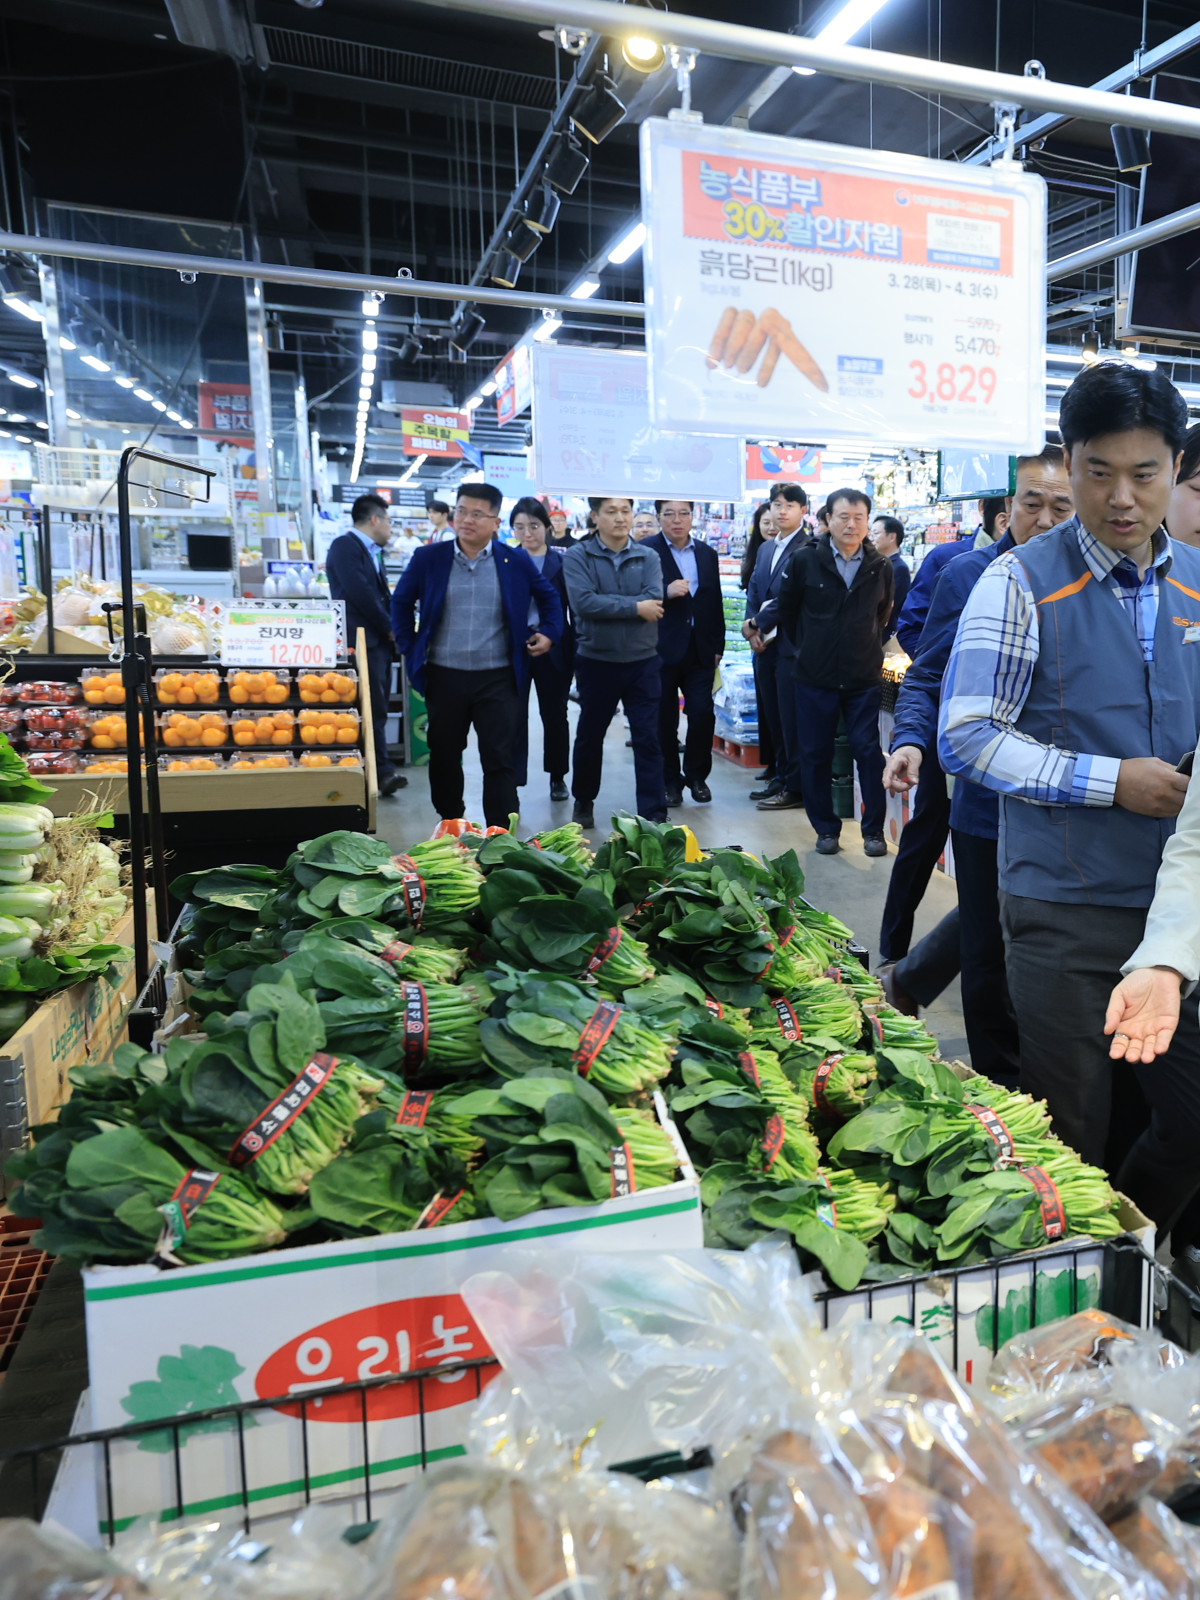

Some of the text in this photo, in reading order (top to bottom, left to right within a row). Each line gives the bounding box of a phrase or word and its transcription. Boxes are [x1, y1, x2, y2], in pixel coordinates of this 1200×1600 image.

[699, 161, 821, 210] 농식품부
[724, 199, 785, 243] 30%
[699, 250, 833, 291] 흙당근(1kg)
[907, 359, 998, 404] 3,829
[259, 626, 304, 639] 진지향
[270, 644, 323, 664] 12,700
